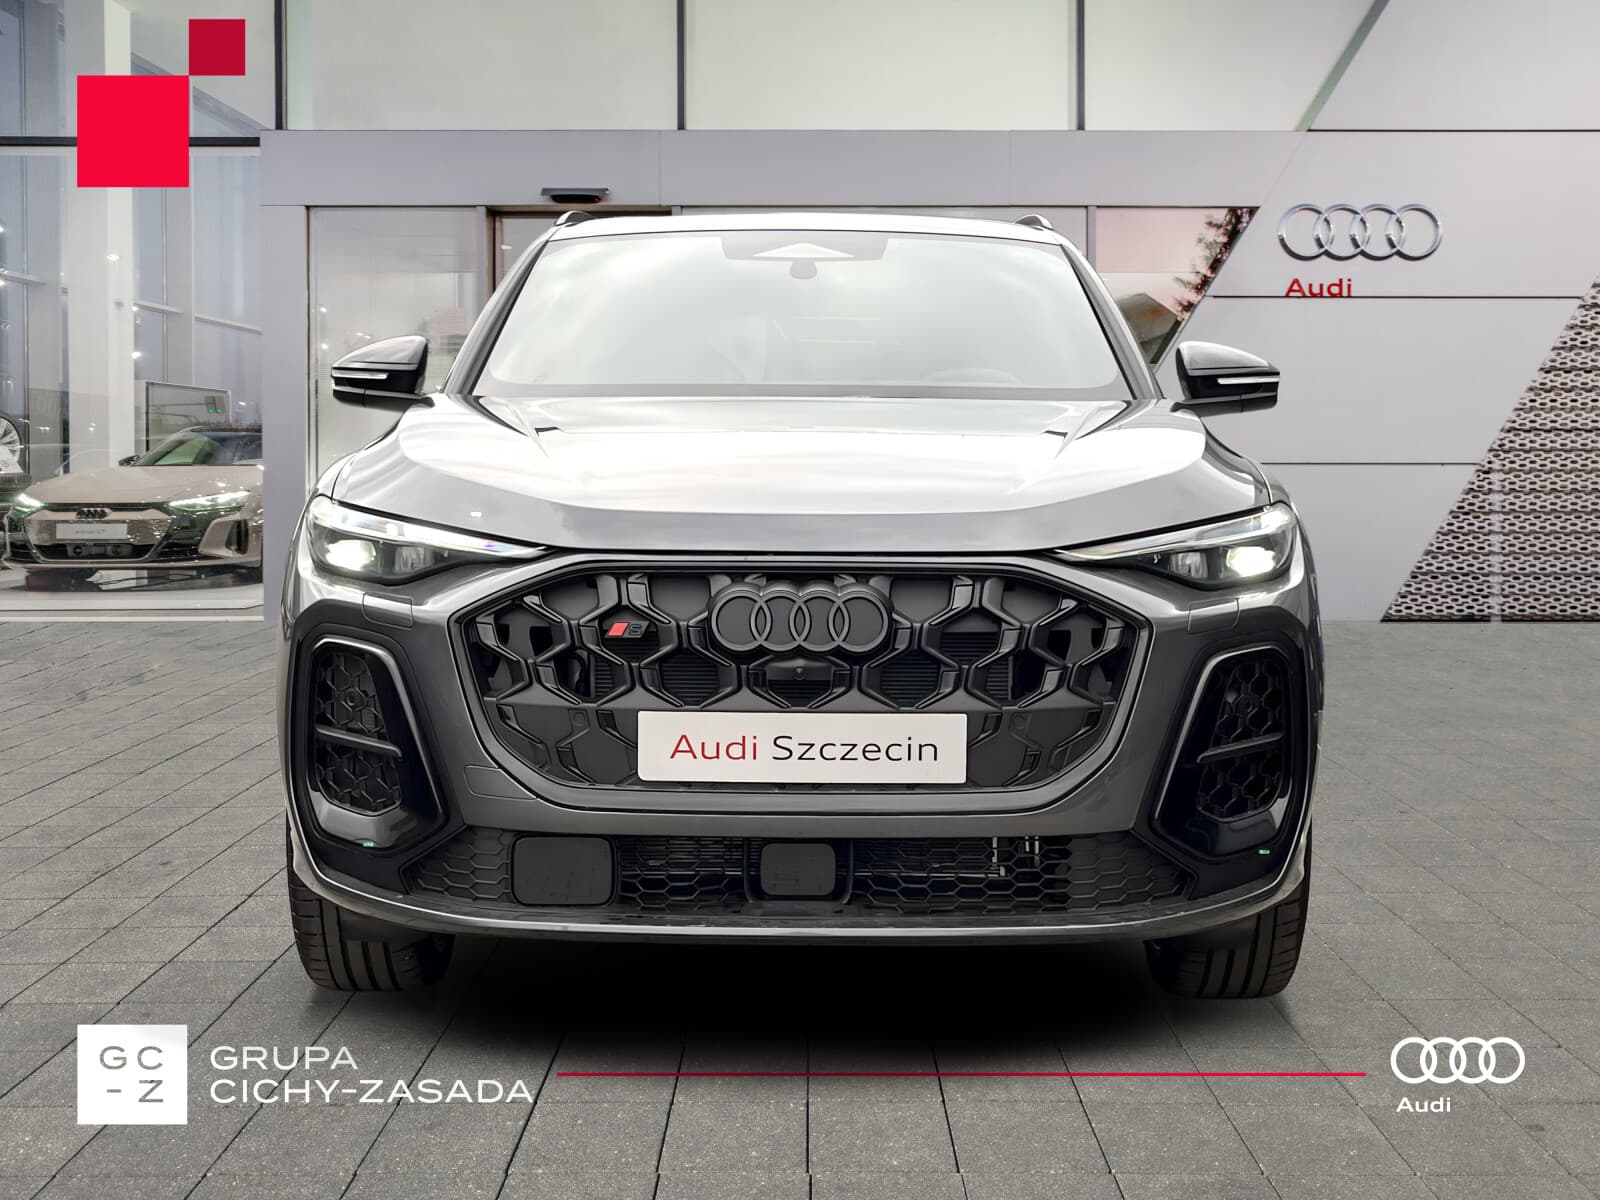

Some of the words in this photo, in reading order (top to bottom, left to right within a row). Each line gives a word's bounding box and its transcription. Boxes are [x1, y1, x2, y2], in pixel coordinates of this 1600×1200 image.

[1285, 277, 1352, 298] Audi
[671, 734, 757, 761] Audi
[772, 735, 938, 762] Szczecin
